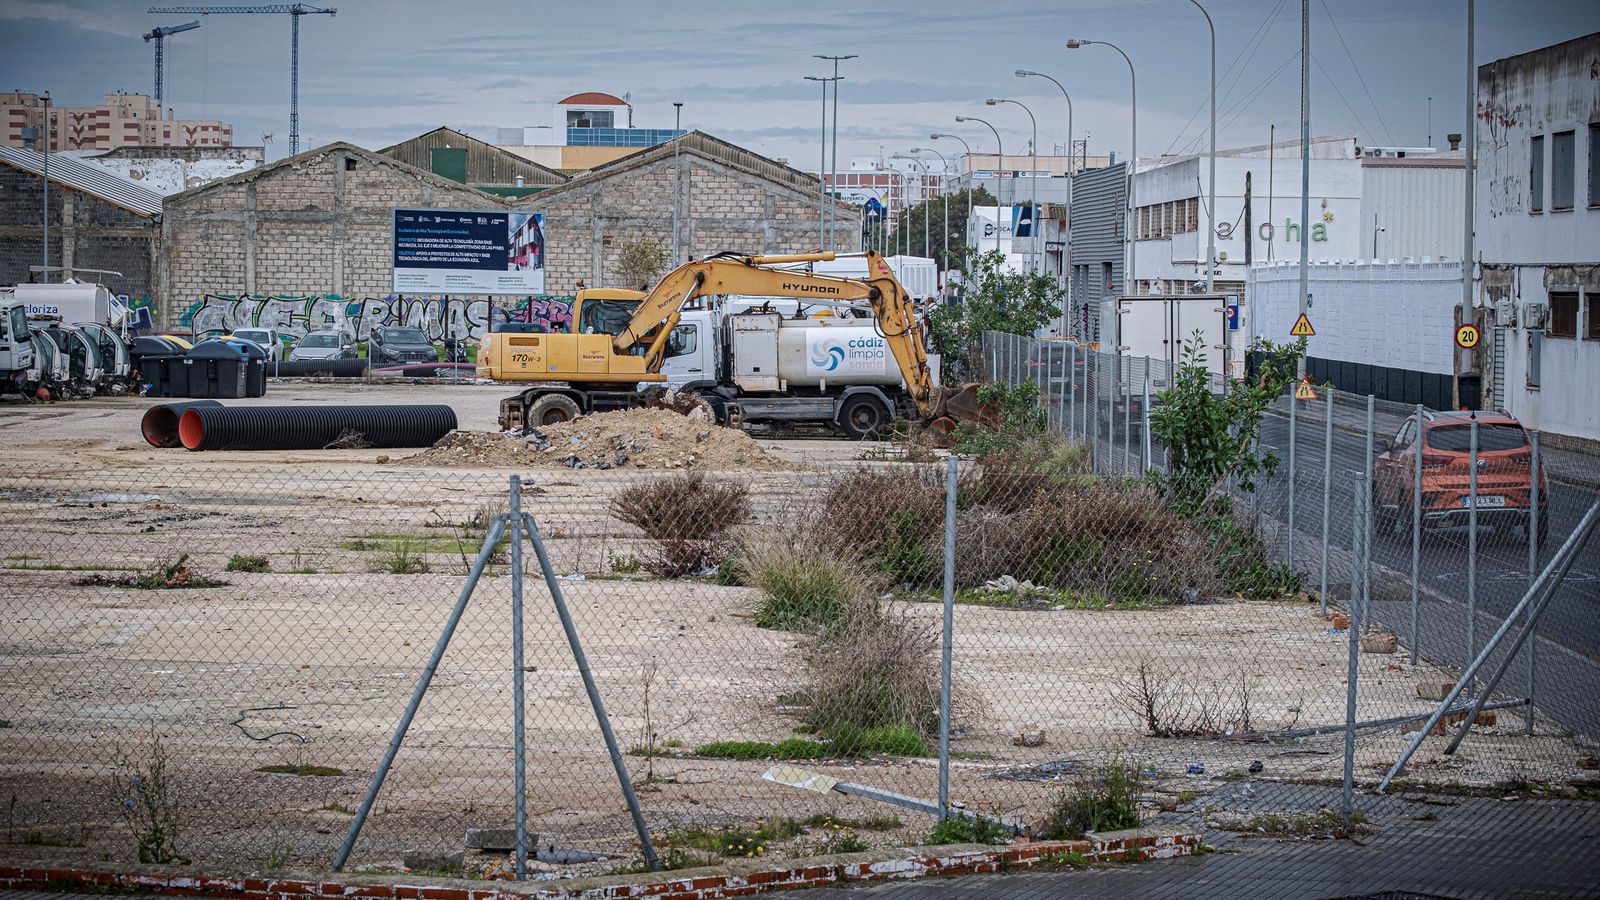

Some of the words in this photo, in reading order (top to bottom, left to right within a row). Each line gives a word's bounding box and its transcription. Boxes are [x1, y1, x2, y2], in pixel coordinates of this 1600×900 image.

[1217, 217, 1328, 242] aoha
[782, 283, 840, 295] HYUNDAI
[848, 336, 884, 348] cádiz
[1462, 331, 1474, 342] 20
[849, 348, 884, 360] limpia
